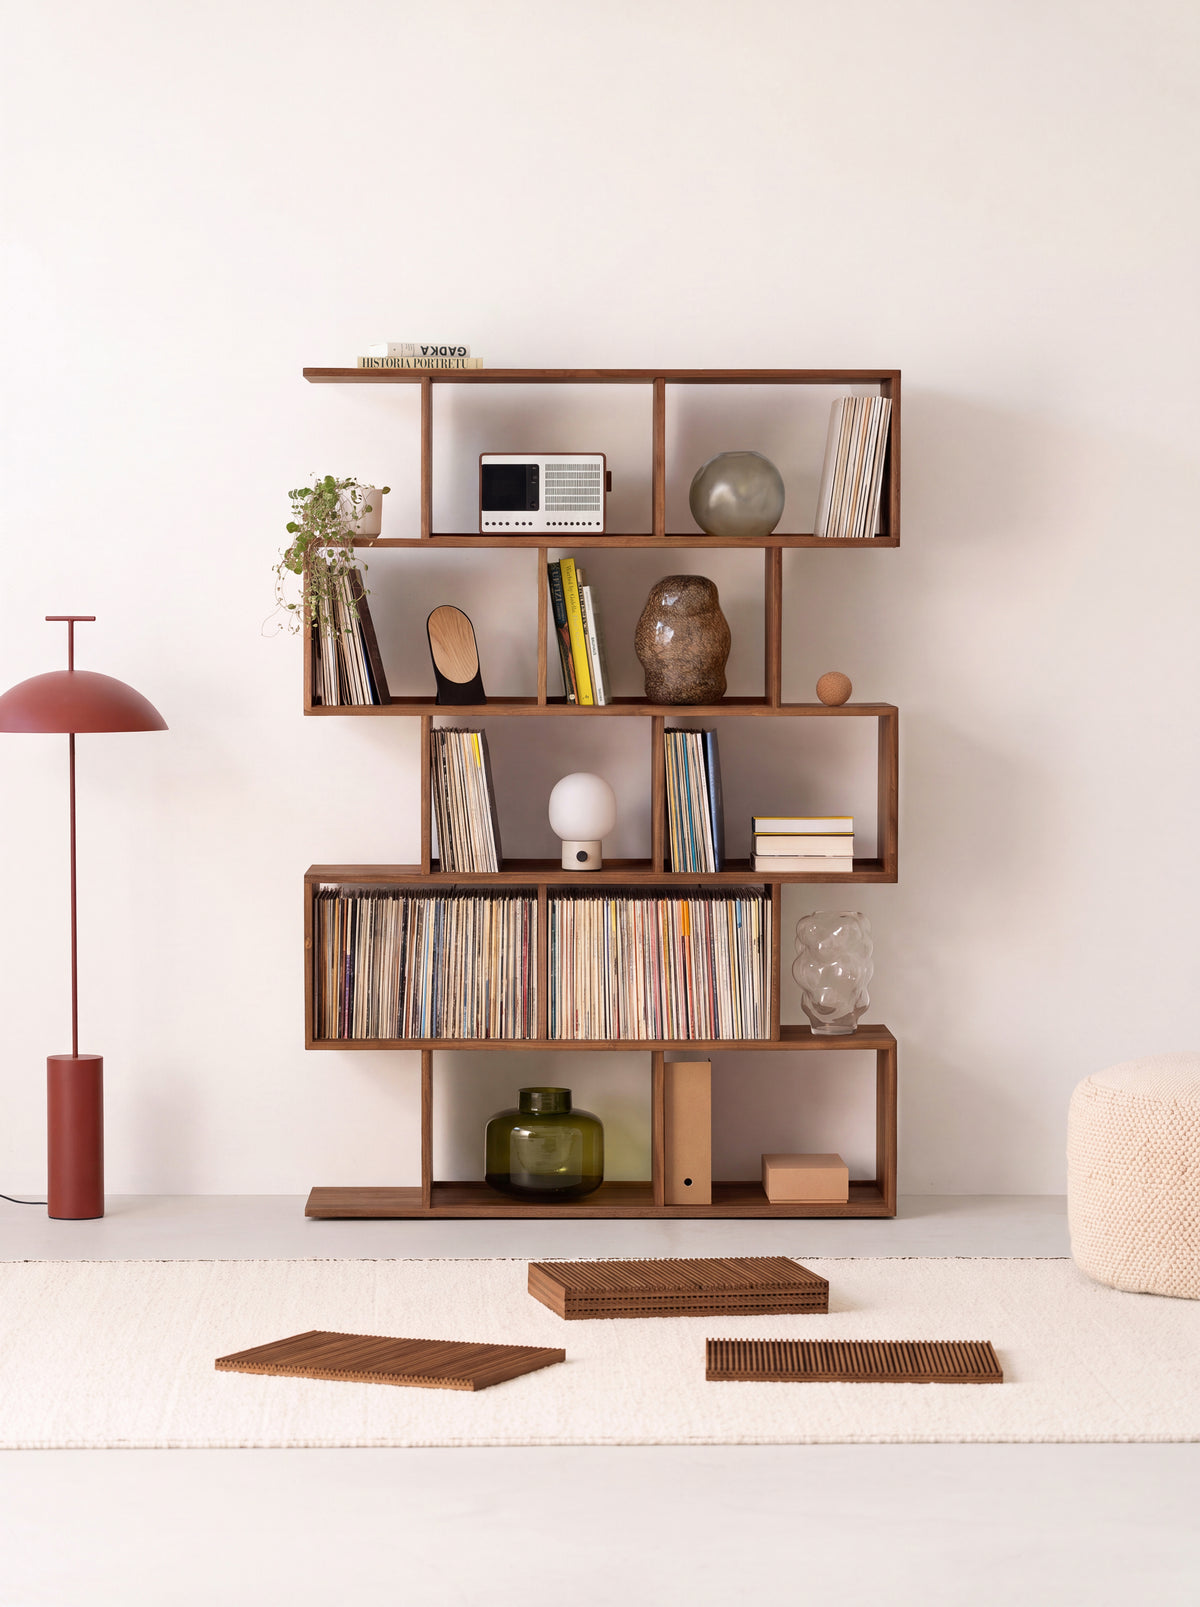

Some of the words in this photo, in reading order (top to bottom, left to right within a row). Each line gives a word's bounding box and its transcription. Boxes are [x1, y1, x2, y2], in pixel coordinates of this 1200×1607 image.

[420, 345, 467, 357] GADKA
[362, 357, 410, 369] HISTORIA
[413, 357, 469, 369] PORTRETU
[552, 571, 562, 602] UFFIZI
